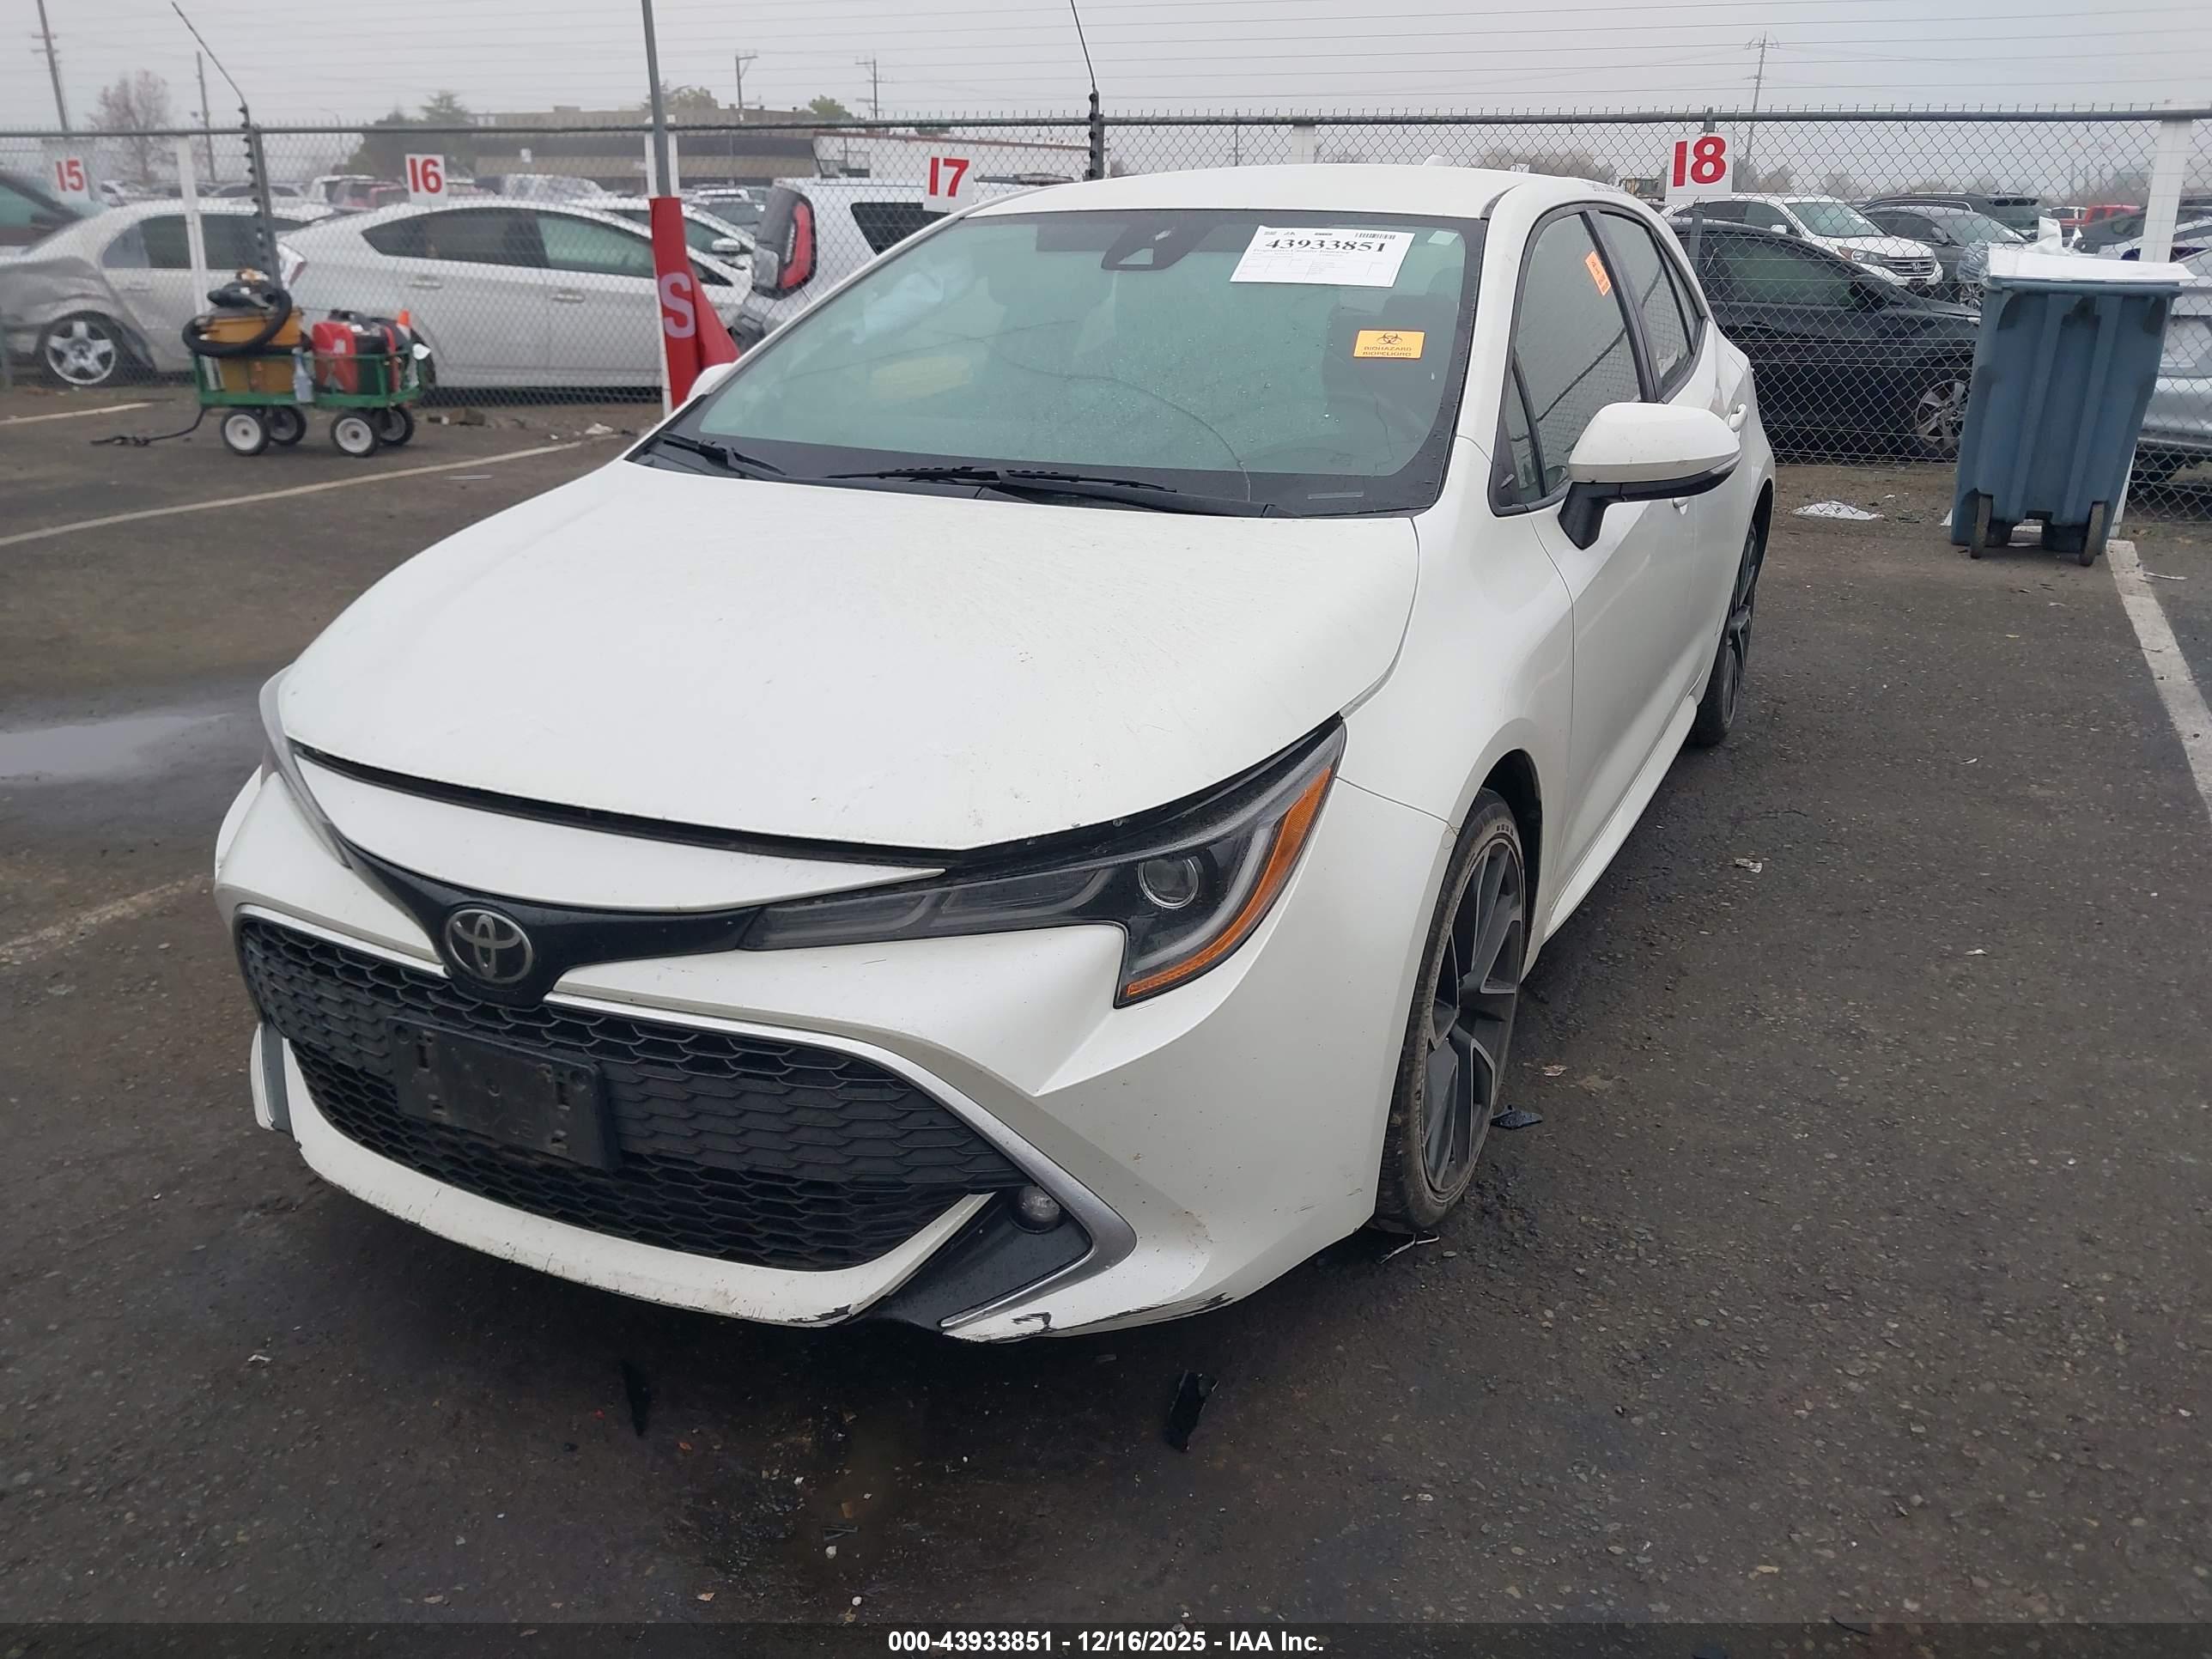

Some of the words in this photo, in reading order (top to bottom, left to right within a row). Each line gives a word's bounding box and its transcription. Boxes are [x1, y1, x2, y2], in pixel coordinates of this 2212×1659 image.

[56, 160, 83, 191] 15
[410, 157, 442, 193] 16
[929, 157, 969, 198] 17
[1673, 136, 1727, 187] 18
[1265, 239, 1385, 252] 43933851
[660, 271, 696, 338] S
